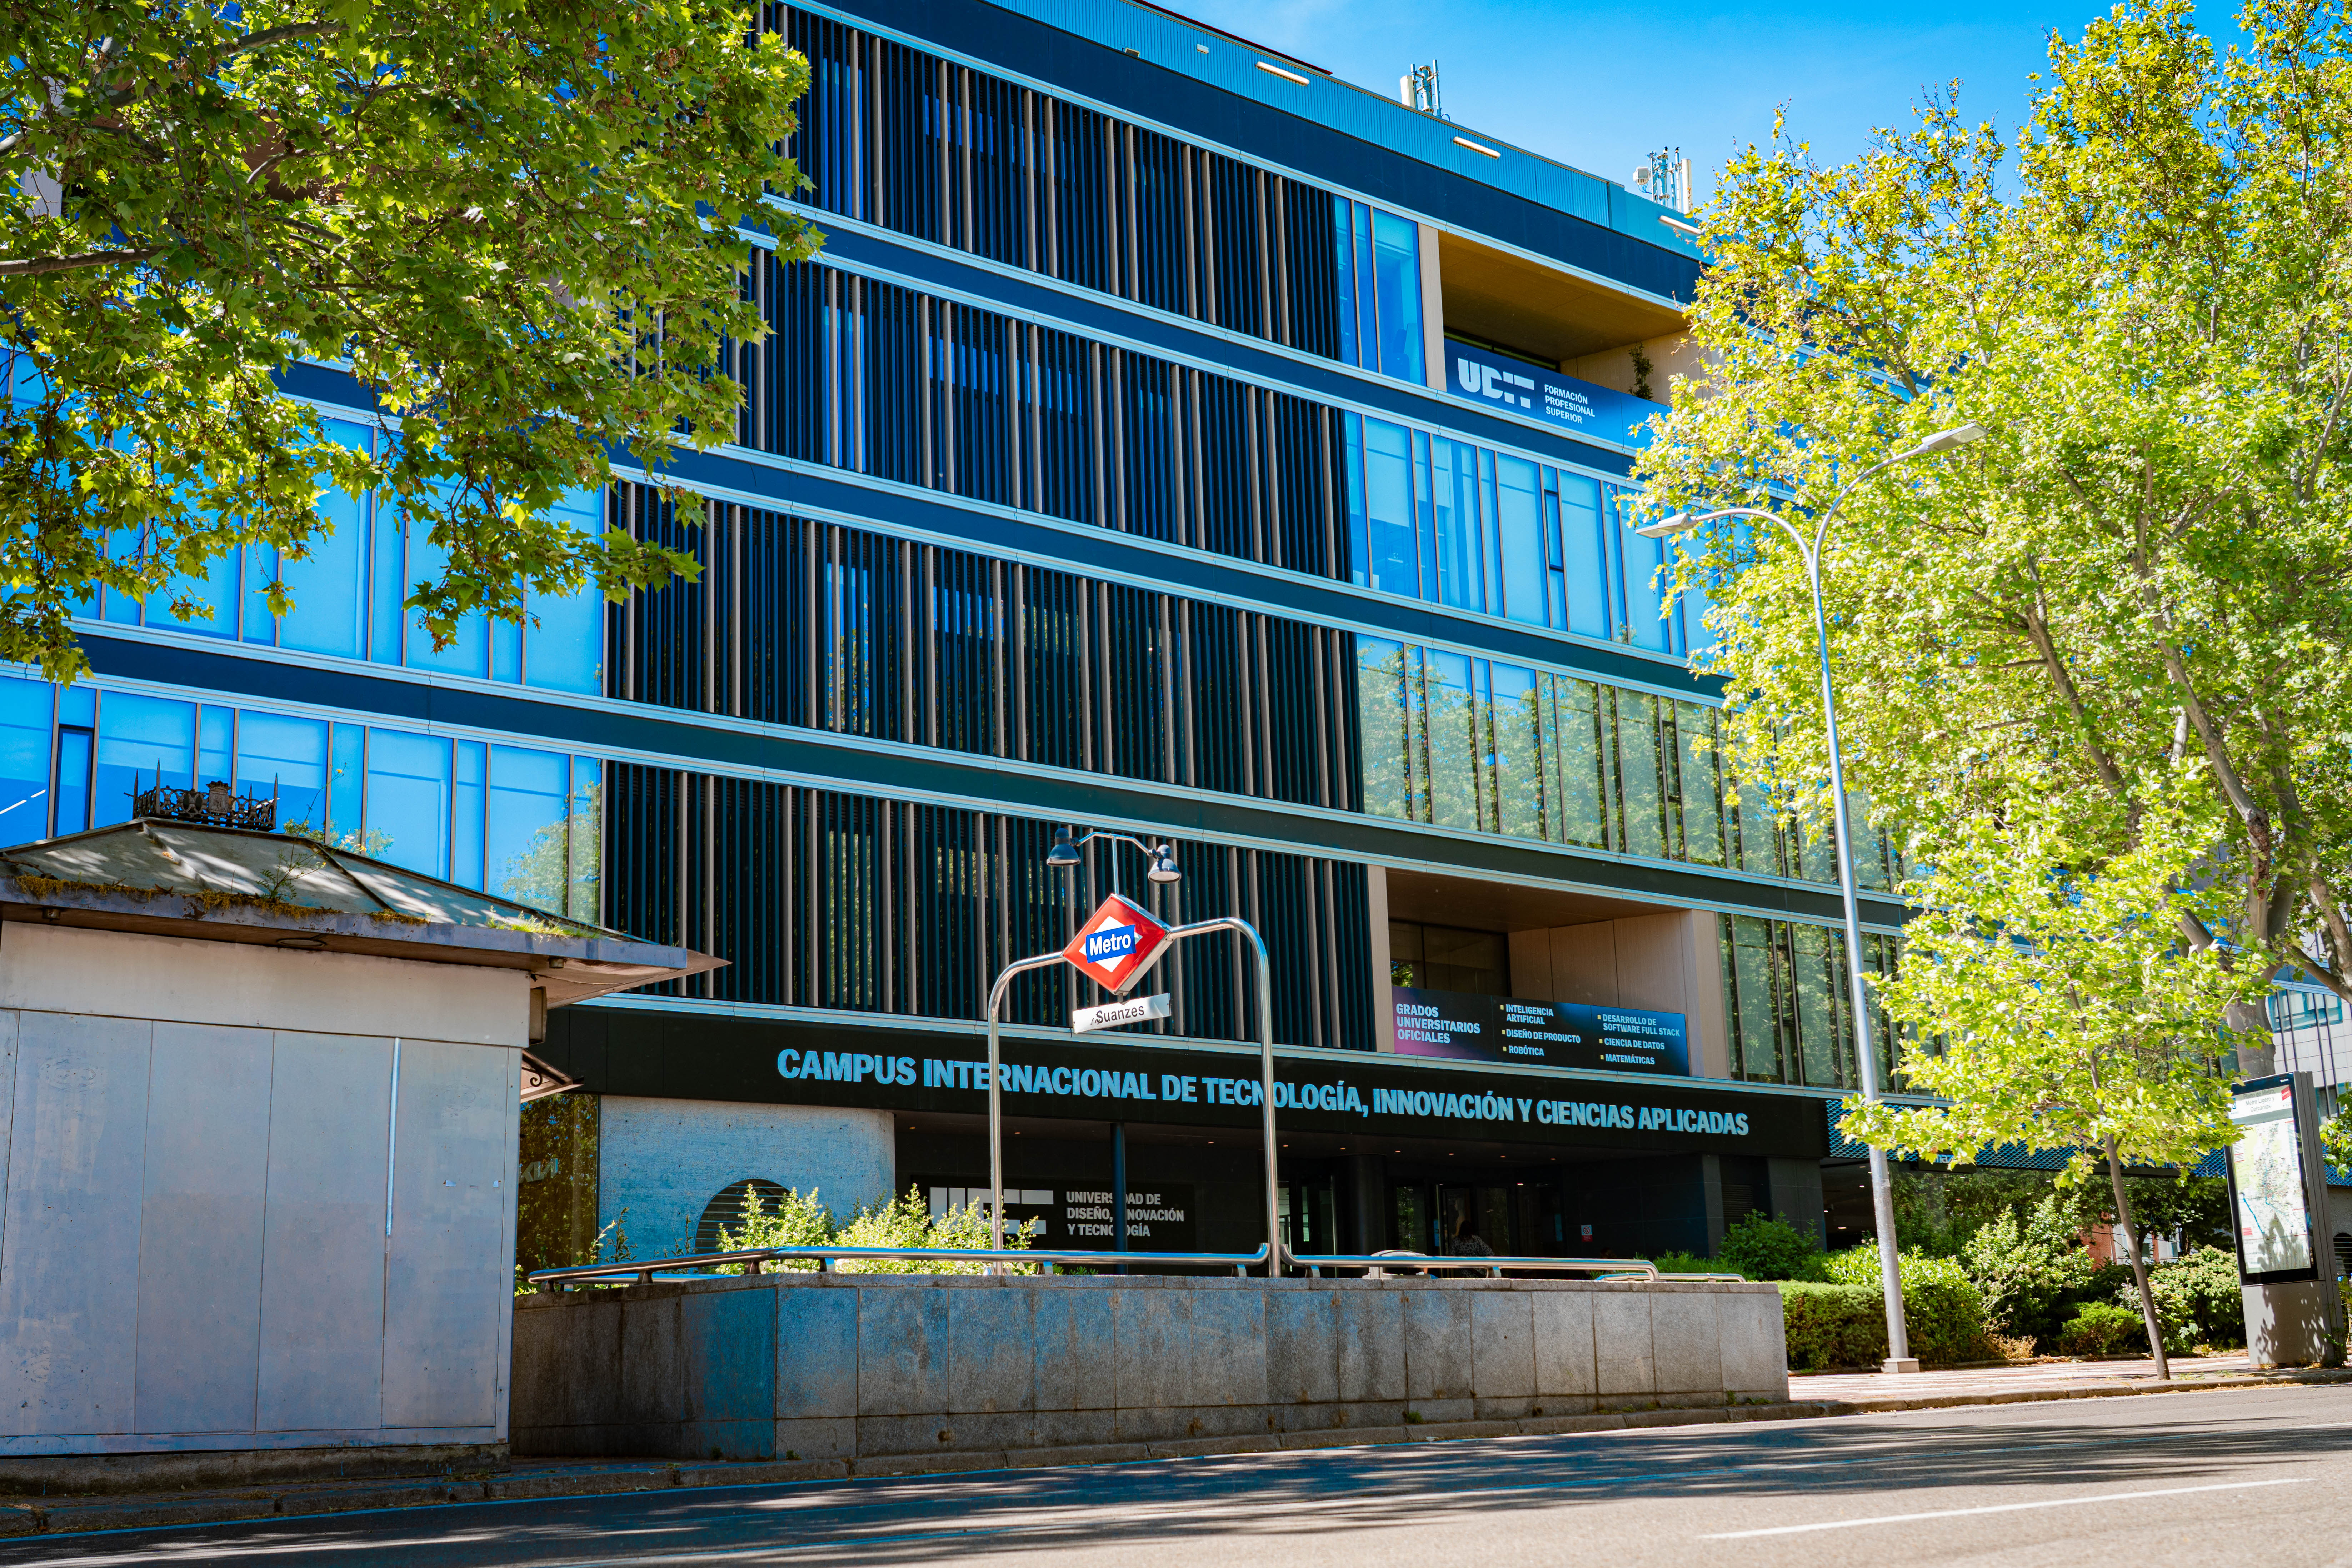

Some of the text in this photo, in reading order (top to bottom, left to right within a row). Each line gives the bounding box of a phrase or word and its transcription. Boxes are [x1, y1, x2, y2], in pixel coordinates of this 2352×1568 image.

[1544, 384, 1588, 405] FORMACIÓN
[1545, 395, 1595, 417] PROFESIONAL
[1546, 406, 1583, 424] SUPERIOR
[1089, 934, 1131, 956] Metro
[1096, 1005, 1144, 1024] Suanzes
[1396, 1003, 1439, 1017] GRADOS
[1505, 1004, 1554, 1017] INTELIGENCIA
[1397, 1016, 1480, 1034] UNIVERSITARIOS
[1506, 1014, 1545, 1024] ARTIFICIAL
[1603, 1014, 1646, 1025] DESARROLLO
[1397, 1029, 1450, 1044] OFICIALES
[1506, 1029, 1581, 1043] DISEÑO DE PRODUCTO
[1603, 1023, 1680, 1037] SOFTWARE FULL STACK
[1508, 1045, 1545, 1056] ROBÓTICA
[1604, 1038, 1632, 1047] CIENCIA
[1643, 1041, 1665, 1050] DATOS
[1605, 1054, 1655, 1065] MATEMÁTICAS
[777, 1049, 1748, 1135] CAMPUS INTERNACIONAL DE TECNOLOGÍA, INNOVACIÓN Y CIENCIAS APLICADAS
[1066, 1191, 1161, 1205] UNIVERSAD DE
[1066, 1206, 1184, 1222] DISEÑO, NOVACIÓN
[1067, 1224, 1076, 1235] Y
